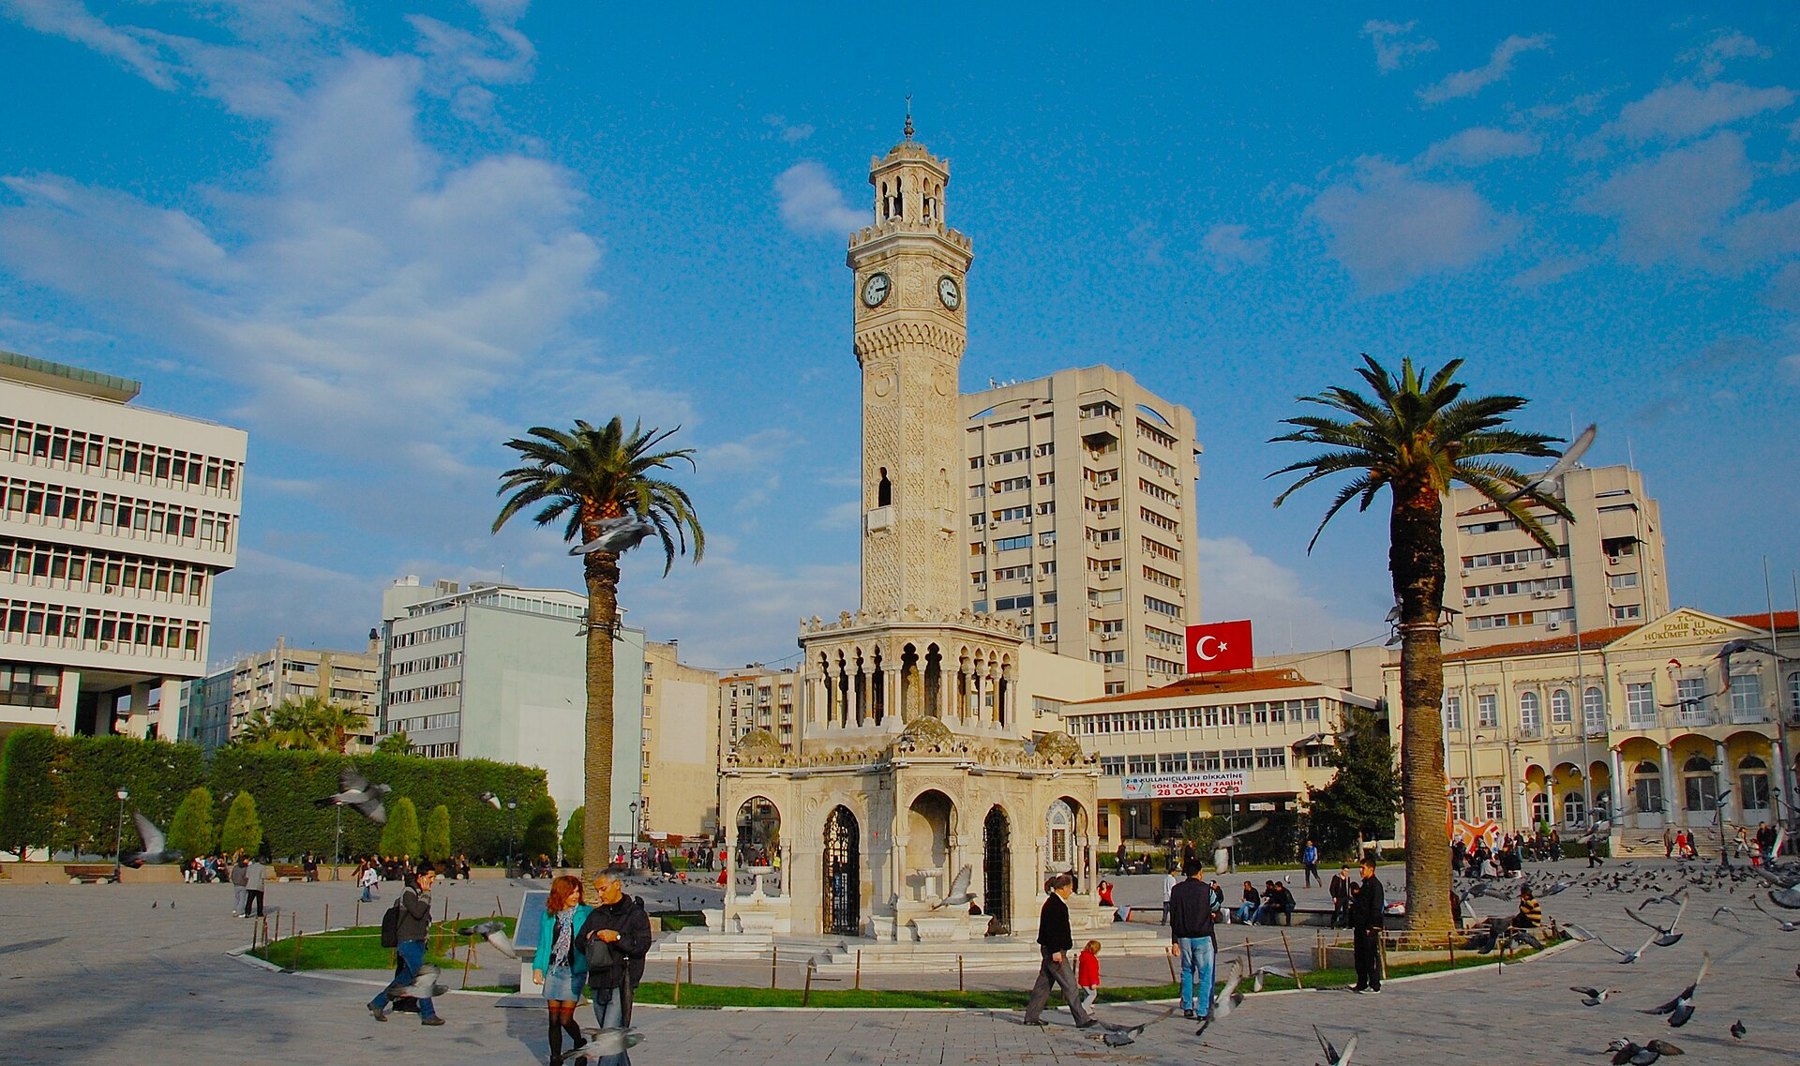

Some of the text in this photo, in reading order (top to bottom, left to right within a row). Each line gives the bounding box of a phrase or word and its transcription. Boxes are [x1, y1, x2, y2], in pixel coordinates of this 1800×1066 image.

[1172, 781, 1212, 789] BAŞVURU
[1215, 779, 1243, 787] TARİHİ
[1157, 786, 1240, 796] 28 OCAK 203
